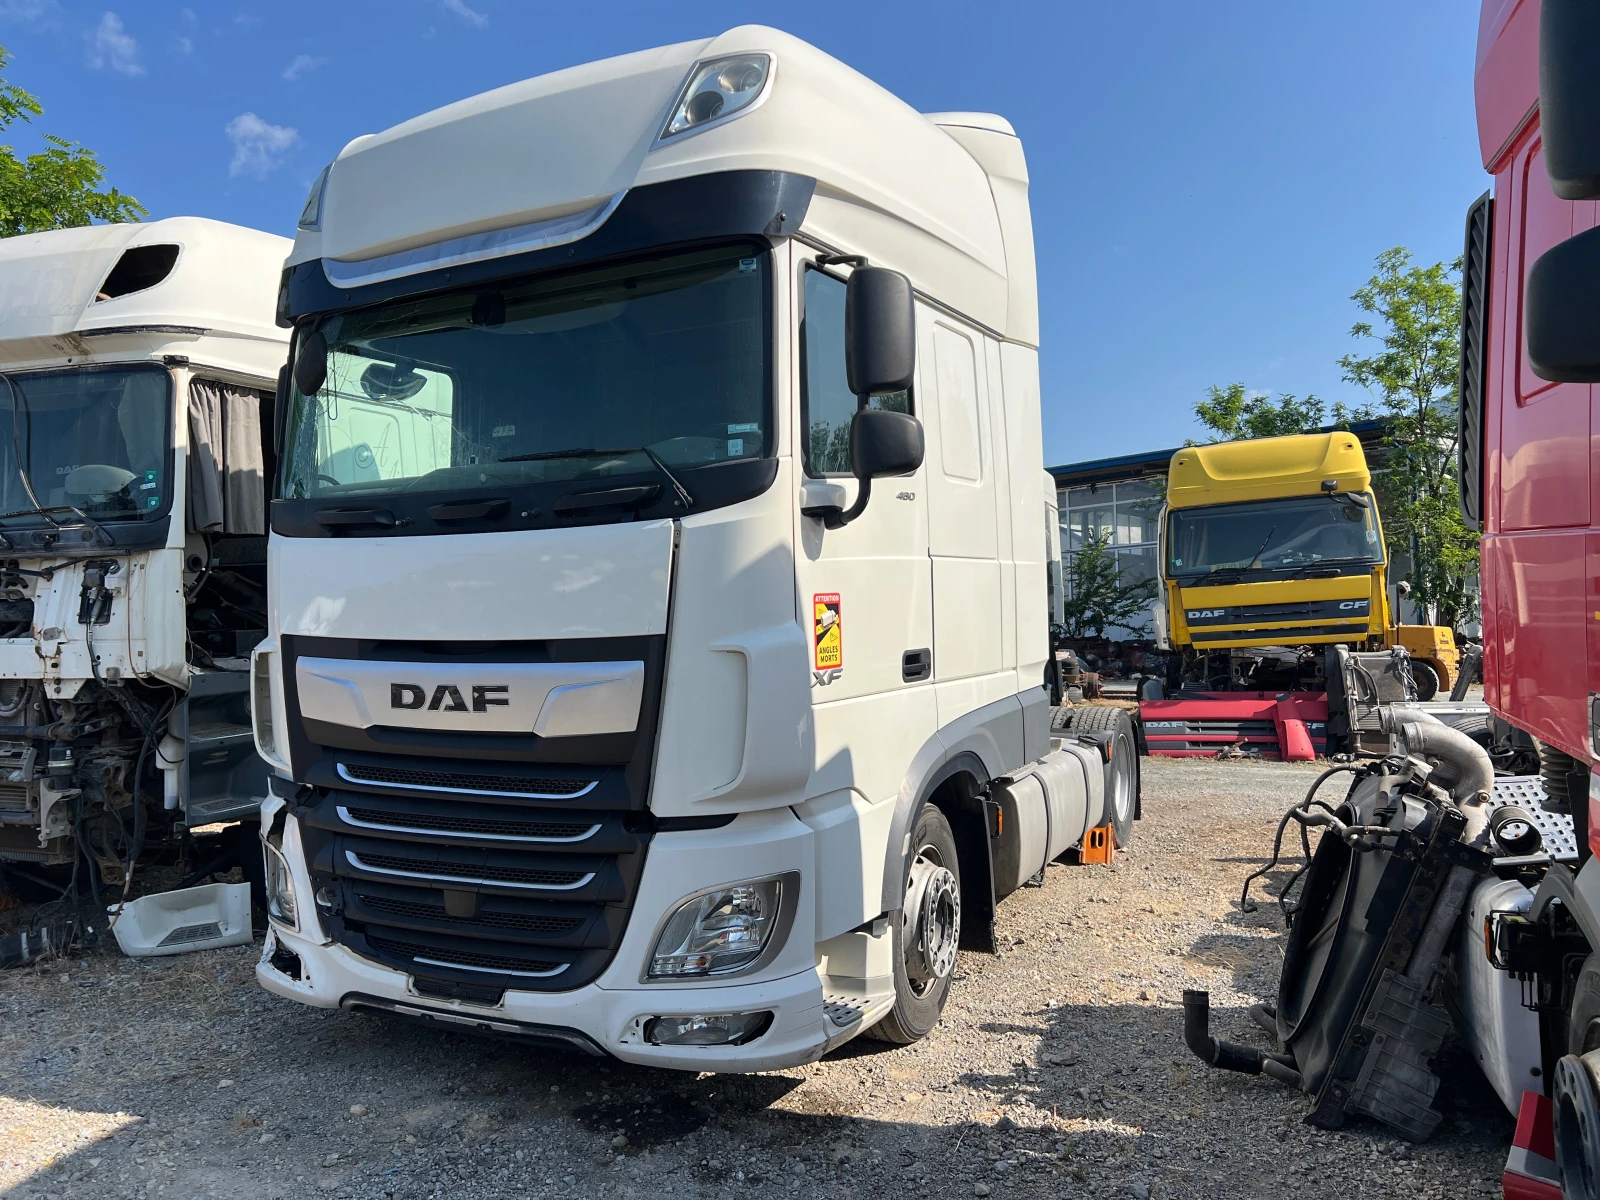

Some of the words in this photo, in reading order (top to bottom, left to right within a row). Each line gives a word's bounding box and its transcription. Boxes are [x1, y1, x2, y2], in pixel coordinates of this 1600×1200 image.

[1338, 600, 1368, 610] CF
[1188, 609, 1225, 619] DAF
[819, 645, 839, 655] ANGLES
[820, 653, 838, 663] MORTS
[810, 667, 843, 688] XF
[390, 682, 509, 713] DAF
